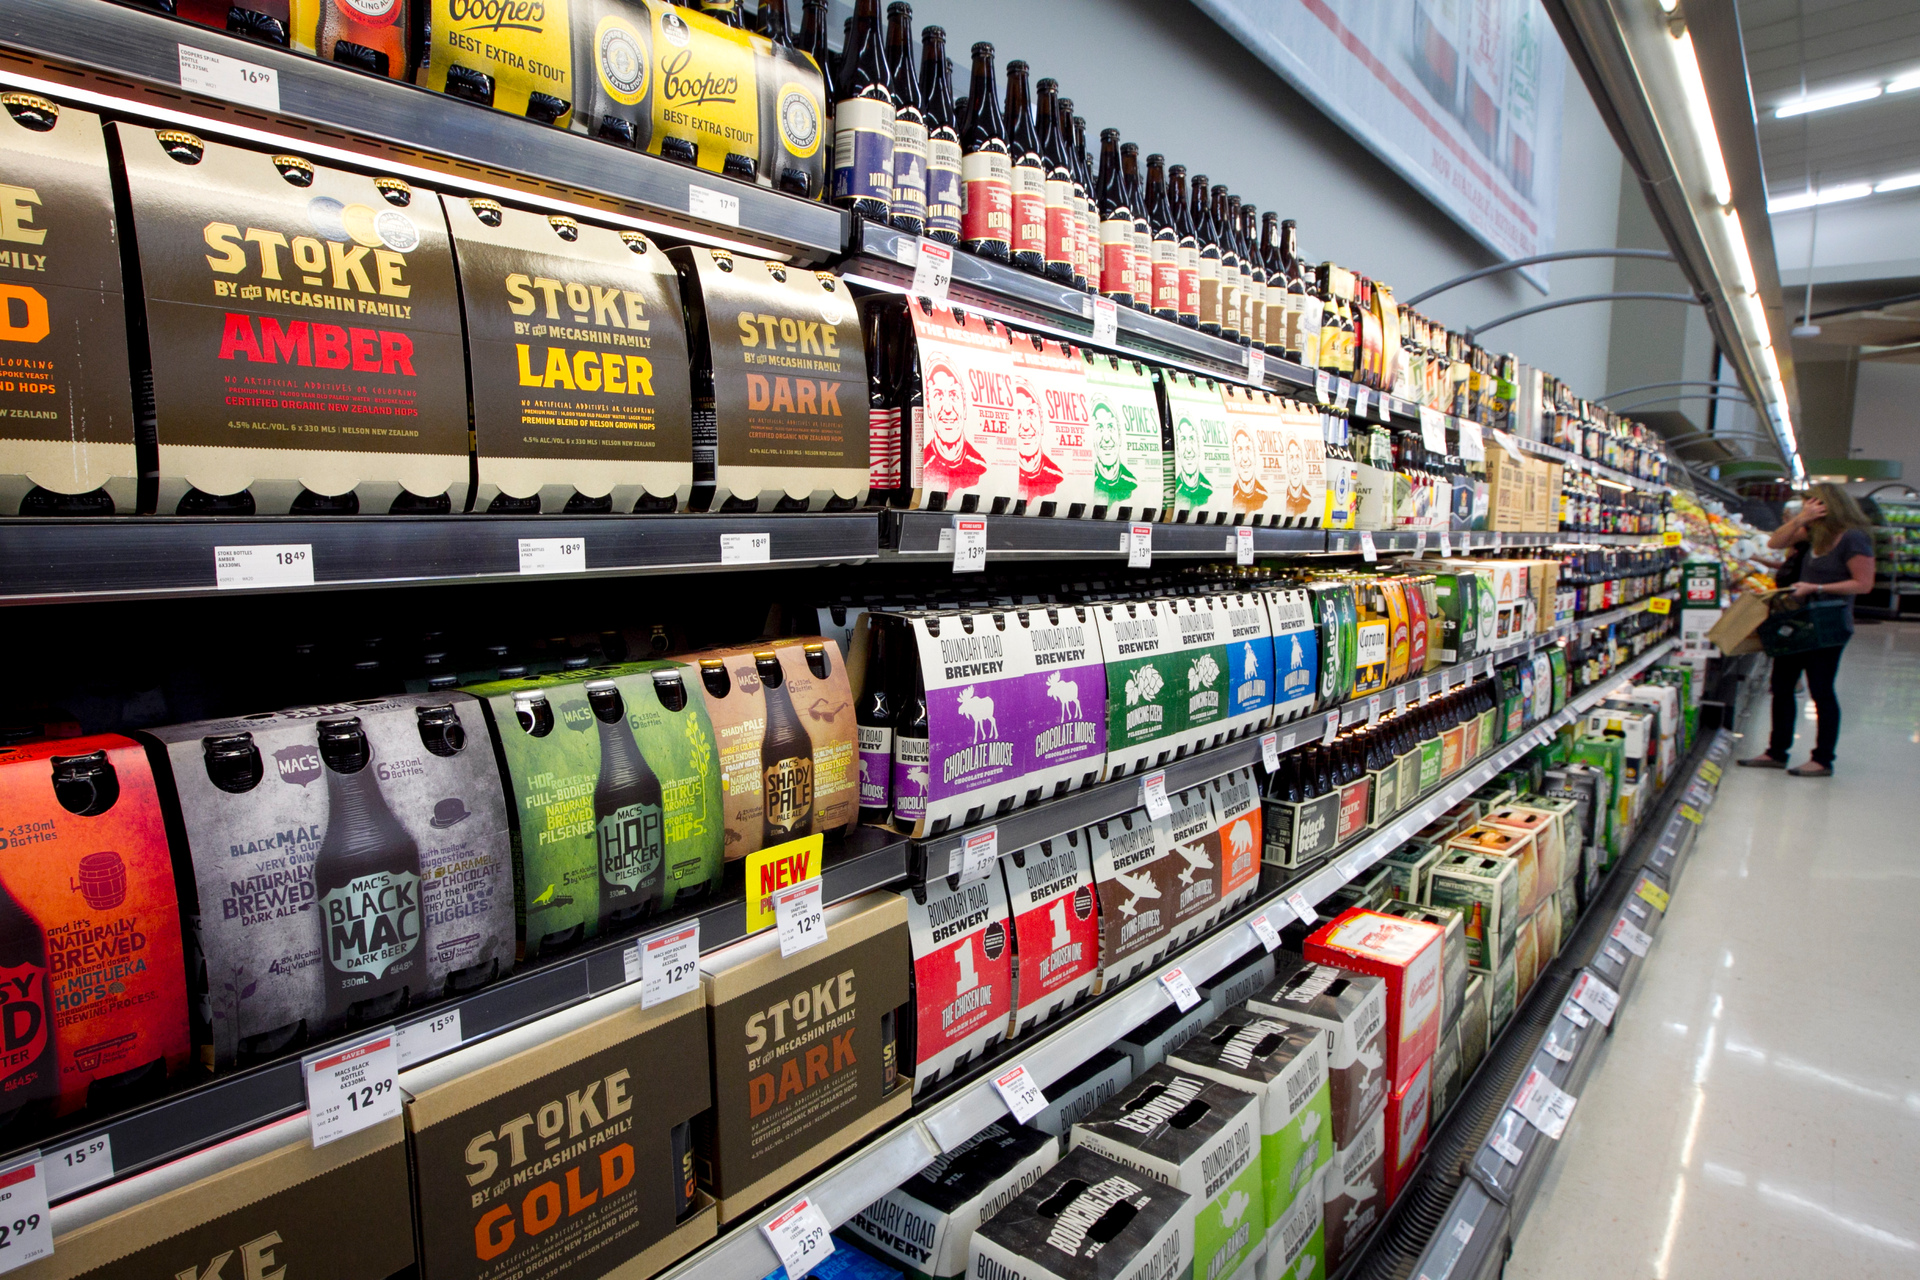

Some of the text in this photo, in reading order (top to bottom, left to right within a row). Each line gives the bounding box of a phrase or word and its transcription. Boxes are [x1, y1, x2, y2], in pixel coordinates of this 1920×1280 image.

[181, 50, 202, 59] COOPERS
[181, 56, 198, 64] BOTTLE
[450, 31, 565, 83] BEST EXTRA STOUT
[661, 50, 738, 106] Coopers
[663, 109, 753, 144] BEST EXTRA STOUT
[203, 221, 412, 298] STOKE
[505, 273, 650, 331] STOKE
[218, 312, 417, 376] AMBER
[738, 311, 840, 358] STOKE
[917, 321, 1010, 350] THE RESIDENT
[515, 343, 655, 396] LAGER
[19, 381, 56, 394] HOPS
[746, 373, 842, 416] DARK
[969, 367, 1014, 408] SPIKE'S
[10, 409, 57, 420] ZEALAND
[225, 396, 418, 416] CERTIFIED ORGANIC NEW ZEALAND HOPS
[979, 409, 1010, 420] RED RYE
[1045, 389, 1089, 423] SPIKE'S
[228, 421, 250, 429] 4.5%
[291, 423, 296, 431] 6
[304, 424, 319, 432] 330
[321, 425, 336, 433] MLS
[342, 426, 370, 435] NELSON
[372, 428, 387, 436] NEW
[389, 428, 419, 437] ZEALAND
[522, 416, 555, 425] PREMIUM
[556, 418, 578, 426] BLEND
[580, 419, 588, 427] OF
[590, 420, 614, 428] NELSON
[982, 418, 1008, 434] ALE
[1055, 426, 1085, 435] RED RYE
[1121, 404, 1158, 435] SPIKE'S
[1200, 418, 1229, 445] SPIKE'S
[1058, 432, 1083, 447] ALE
[1127, 441, 1160, 452] PILSNER
[1204, 452, 1230, 462] PILSNER
[1690, 591, 1712, 599] 25
[1232, 625, 1261, 637] BREWERY
[1280, 619, 1306, 630] BREWERY
[940, 634, 1003, 665] BOUNDARY ROAD
[1030, 626, 1085, 652] BOUNDARY ROAD
[1118, 639, 1159, 655] BREWERY
[1182, 632, 1215, 644] BREWERY
[1322, 599, 1340, 698] Carlsberg
[1360, 629, 1384, 652] Corona
[945, 660, 1004, 680] BREWERY
[1035, 649, 1086, 666] BREWERY
[563, 707, 592, 723] MAC'S
[1035, 721, 1096, 758] CHOCOLATE MOOSE
[278, 753, 320, 776] MAC'S
[779, 759, 799, 770] MAC'S
[943, 742, 1014, 784] CHOCOLATE MOOSE
[768, 765, 809, 793] SHADY
[526, 782, 594, 809] FULL-BODIED
[546, 796, 593, 817] NATURALLY
[768, 784, 810, 817] PALE
[547, 807, 593, 831] BREWED
[617, 807, 642, 820] MAC'S
[1224, 800, 1251, 819] BREWERY
[1340, 816, 1349, 825] RED
[1341, 801, 1360, 817] CELTIC
[8, 819, 55, 837] x330ml
[539, 821, 595, 846] PILSENER
[604, 813, 658, 858] HOP
[1173, 821, 1208, 843] BREWERY
[1300, 814, 1325, 838] black
[1340, 822, 1351, 832] BEER
[10, 831, 57, 848] Bottles
[1298, 832, 1320, 853] beer
[256, 855, 315, 872] VERY OWN
[605, 843, 659, 874] ROCKER
[1113, 846, 1156, 871] BREWERY
[230, 864, 314, 897] NATURALLY
[352, 874, 391, 894] MAC'S
[443, 863, 502, 888] CHOCOLATE
[615, 863, 651, 881] PILSENER
[760, 850, 810, 896] NEW
[423, 879, 486, 903] and the HOPS
[1030, 872, 1078, 903] BREWERY
[222, 881, 315, 920] BREWED
[329, 882, 416, 925] BLACK
[927, 882, 989, 929] BOUNDARY ROAD
[241, 905, 297, 927] DARK ALE
[425, 899, 493, 928] FUGGLES.
[932, 907, 990, 944] BREWERY
[1049, 898, 1071, 950] 1
[49, 917, 137, 952] NATURALLY
[331, 906, 418, 961] MAC
[664, 936, 680, 945] SAVER
[49, 932, 146, 974] BREWED
[346, 943, 408, 969] DARK BEER
[653, 952, 665, 960] MACS
[665, 948, 673, 956] HOP
[954, 937, 979, 996] 1
[56, 984, 106, 1012] HOPS
[745, 968, 857, 1055] STOKE
[341, 1048, 366, 1062] SAVER
[335, 1061, 370, 1078] MACS BLACK
[341, 1070, 364, 1082] BOTTLES
[748, 1027, 857, 1119] DARK
[340, 1076, 367, 1089] 6X330ML
[1289, 1075, 1321, 1115] BREWERY
[326, 1105, 340, 1114] 15.59
[327, 1115, 339, 1123] 2.60
[465, 1068, 634, 1187] STOKE
[1205, 1149, 1250, 1200] BREWERY
[1344, 1149, 1376, 1184] BREWERY
[474, 1142, 636, 1262] GOLD
[525, 1205, 638, 1275] ORGANIC NEW ZEALAND HOPS
[903, 1211, 936, 1249] ROAD
